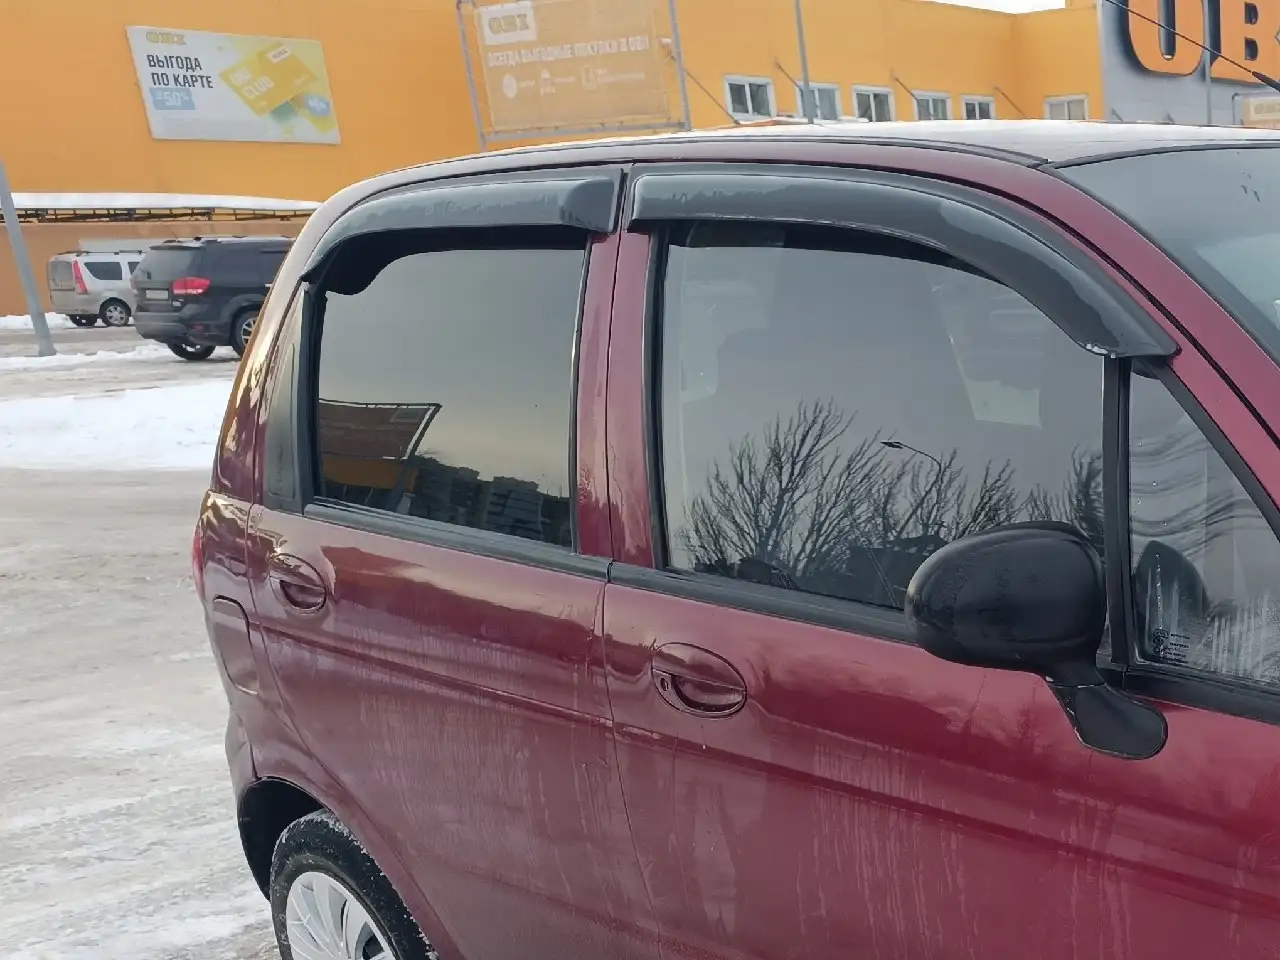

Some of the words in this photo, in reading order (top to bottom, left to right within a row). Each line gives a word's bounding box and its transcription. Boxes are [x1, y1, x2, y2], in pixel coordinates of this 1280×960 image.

[146, 54, 203, 73] ВЫГОДА
[151, 72, 170, 86] ПО
[172, 73, 214, 88] КАРТЕ
